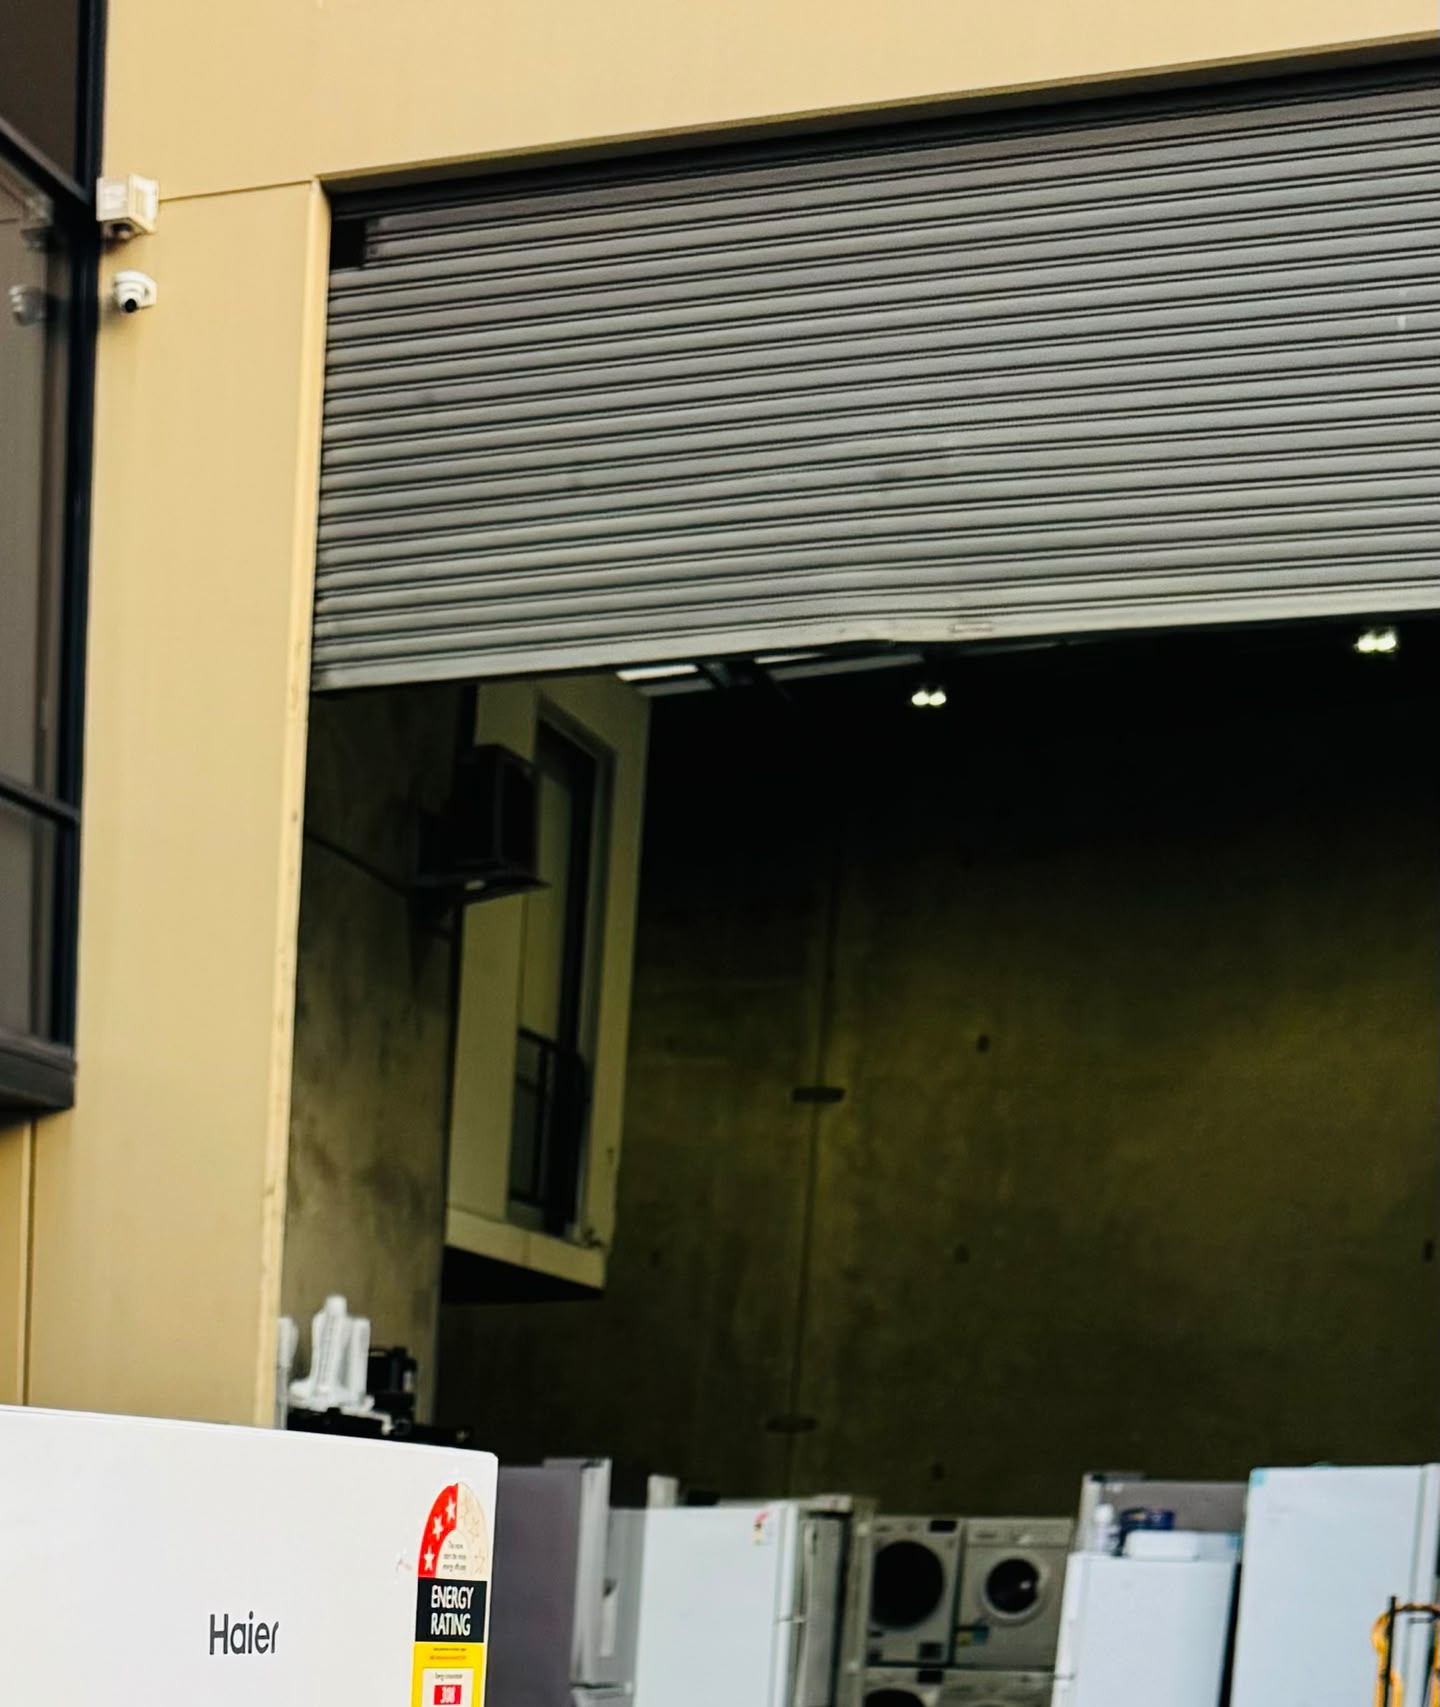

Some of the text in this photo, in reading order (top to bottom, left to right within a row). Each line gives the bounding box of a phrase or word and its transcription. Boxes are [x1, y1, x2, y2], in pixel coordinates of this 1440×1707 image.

[431, 1584, 474, 1609] ENERGY
[209, 1610, 279, 1655] Haier
[430, 1612, 471, 1636] RATING
